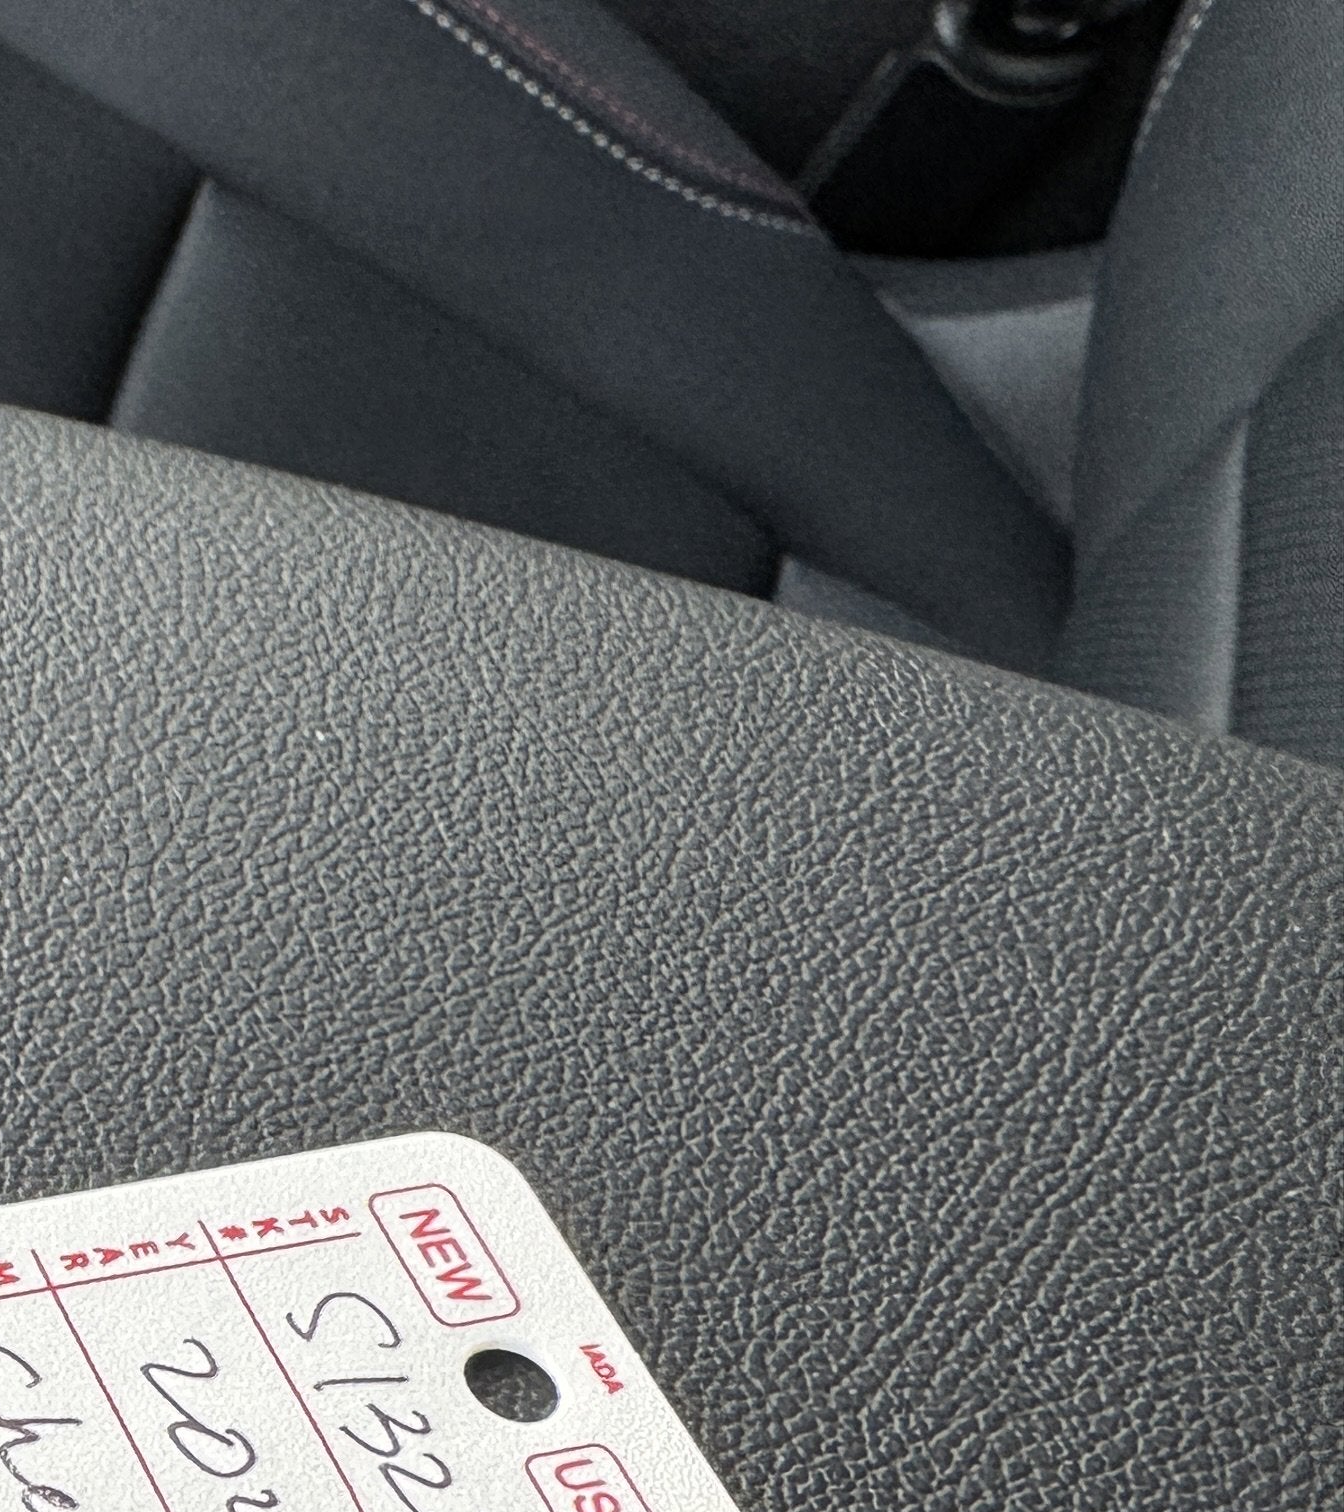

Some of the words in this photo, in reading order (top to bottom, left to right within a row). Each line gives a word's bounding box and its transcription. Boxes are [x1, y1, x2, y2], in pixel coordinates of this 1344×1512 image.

[218, 1207, 350, 1240] STK#
[63, 1233, 196, 1271] YEAR
[400, 1207, 492, 1302] NEW
